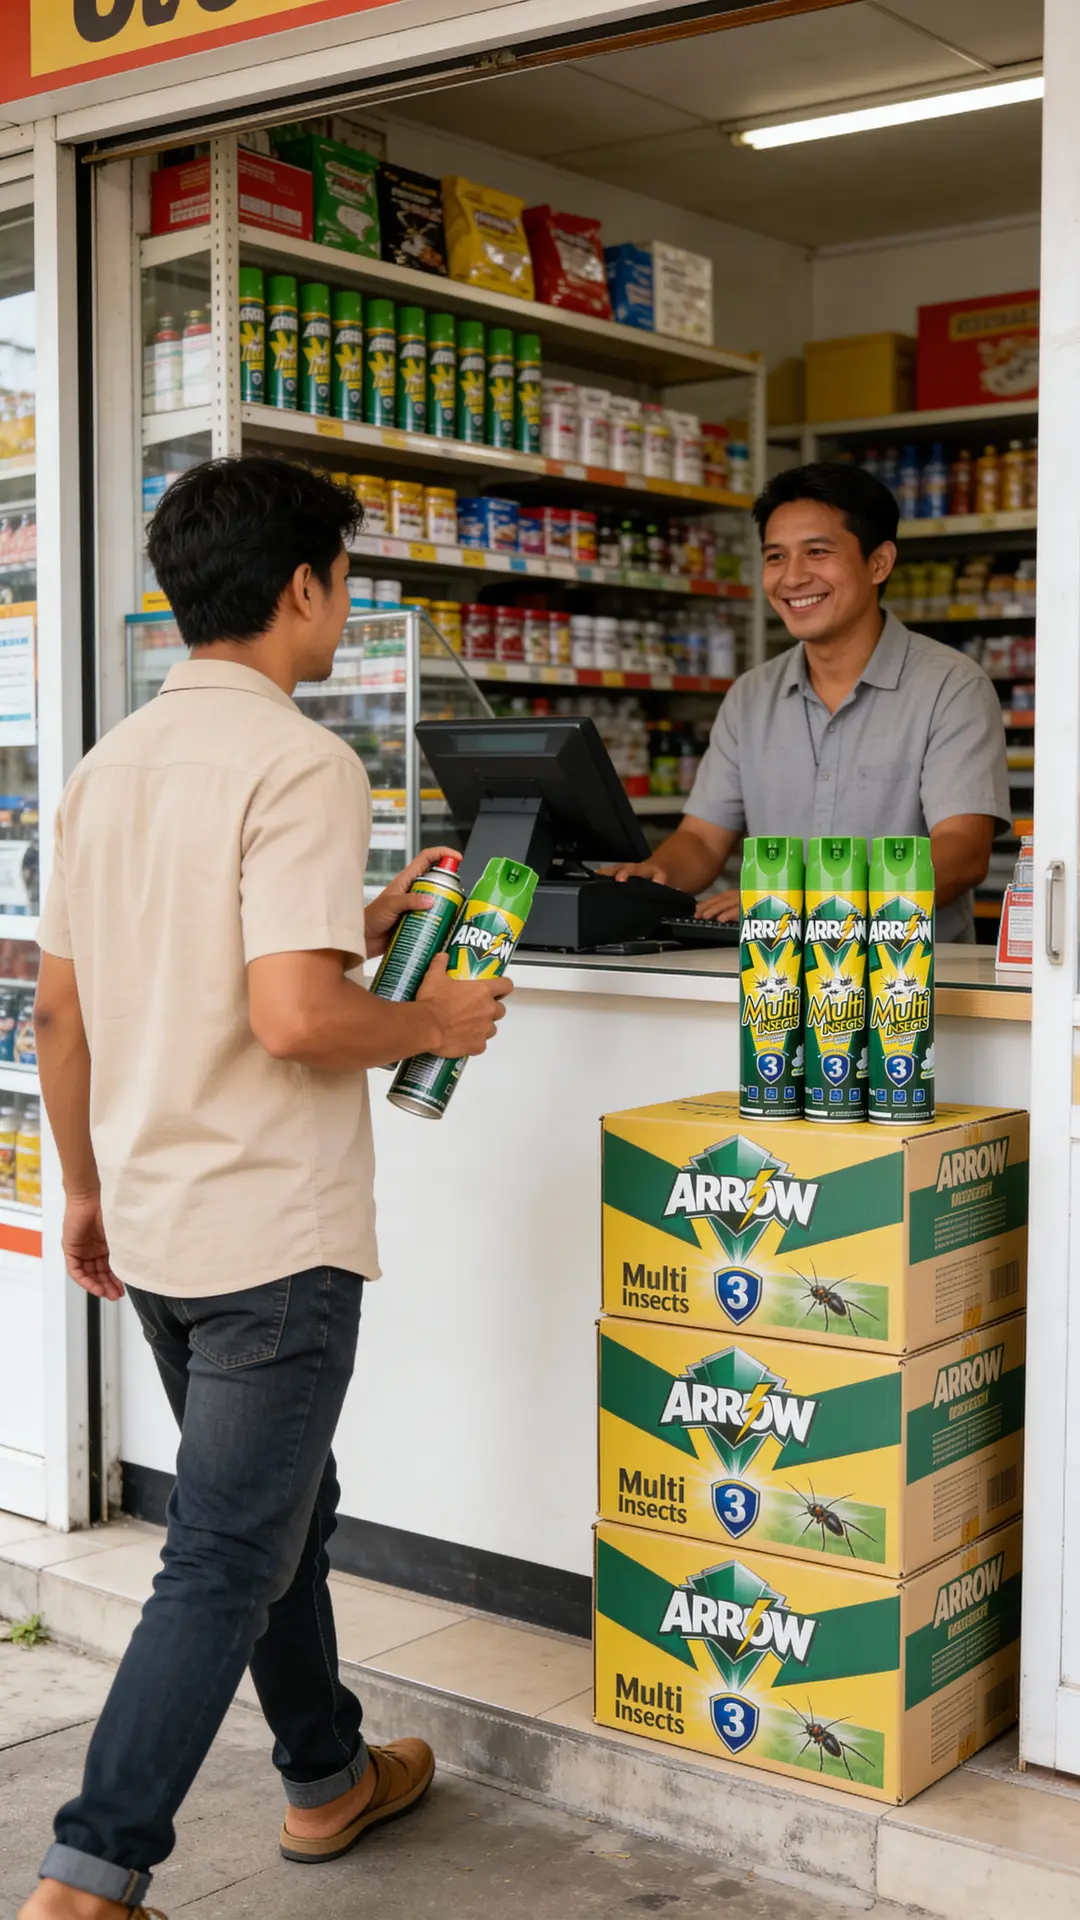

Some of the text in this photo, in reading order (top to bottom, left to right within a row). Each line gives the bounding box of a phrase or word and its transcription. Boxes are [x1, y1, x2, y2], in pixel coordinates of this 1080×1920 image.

[450, 924, 515, 965] ARROW
[740, 918, 801, 944] ARROW
[804, 919, 867, 945] ARROW
[868, 919, 932, 946] ARROW
[742, 989, 800, 1026] Multi
[806, 989, 865, 1027] Multi
[871, 989, 930, 1028] Multi
[763, 1056, 779, 1077] 3
[827, 1057, 843, 1078] 3
[892, 1057, 908, 1079] 3
[935, 1138, 1008, 1194] ARROW
[663, 1172, 819, 1227] ARROW
[622, 1261, 688, 1294] Multi
[726, 1275, 749, 1310] 3
[622, 1287, 690, 1314] Insects
[932, 1346, 1004, 1410] ARROW
[659, 1379, 817, 1444] ARROW
[618, 1467, 685, 1504] Multi
[617, 1493, 688, 1524] Insects
[723, 1488, 746, 1524] 3
[932, 1554, 1004, 1630] ARROW
[658, 1589, 817, 1663] ARROW
[615, 1672, 683, 1714] Multi
[614, 1699, 685, 1735] Insects
[722, 1702, 746, 1738] 3
